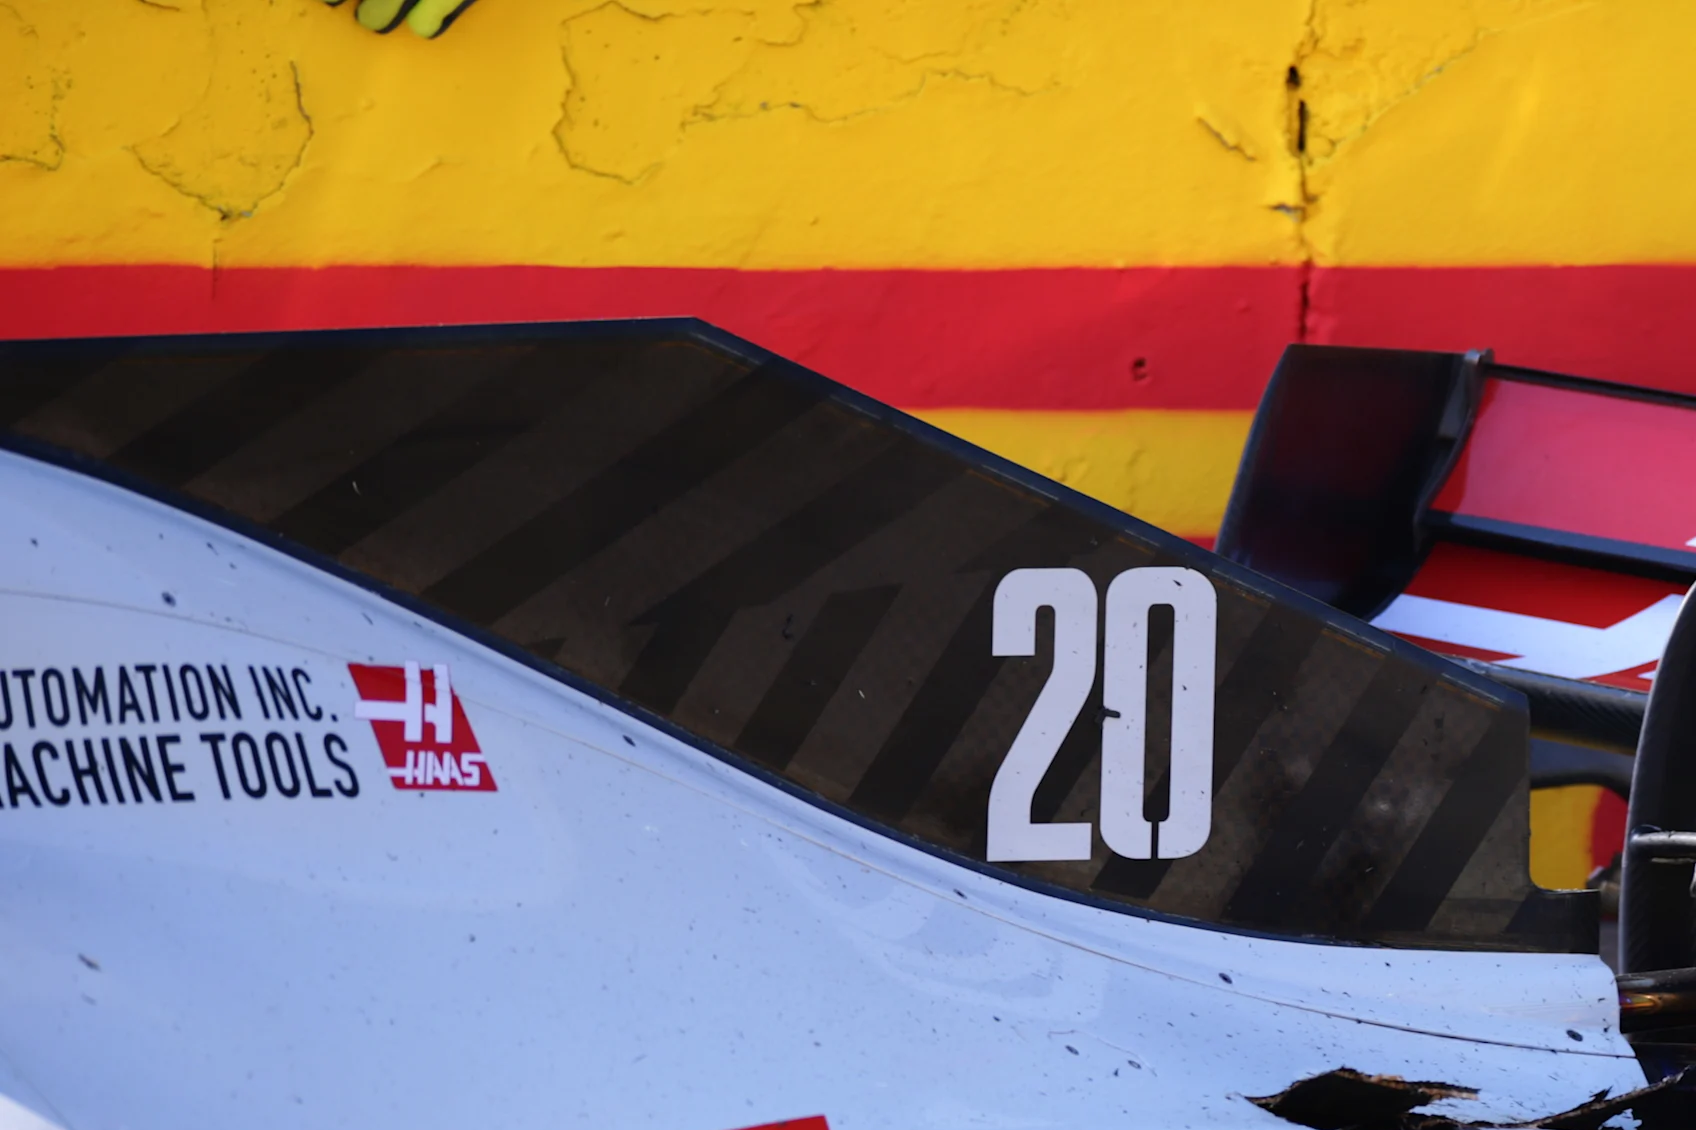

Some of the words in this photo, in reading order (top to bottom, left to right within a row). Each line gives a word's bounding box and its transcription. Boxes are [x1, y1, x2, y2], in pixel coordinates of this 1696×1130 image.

[247, 664, 339, 723] INC.
[987, 566, 1217, 862] 20
[0, 733, 196, 810] ACHINE
[199, 731, 360, 801] TOOLS
[387, 749, 486, 786] HAAS
